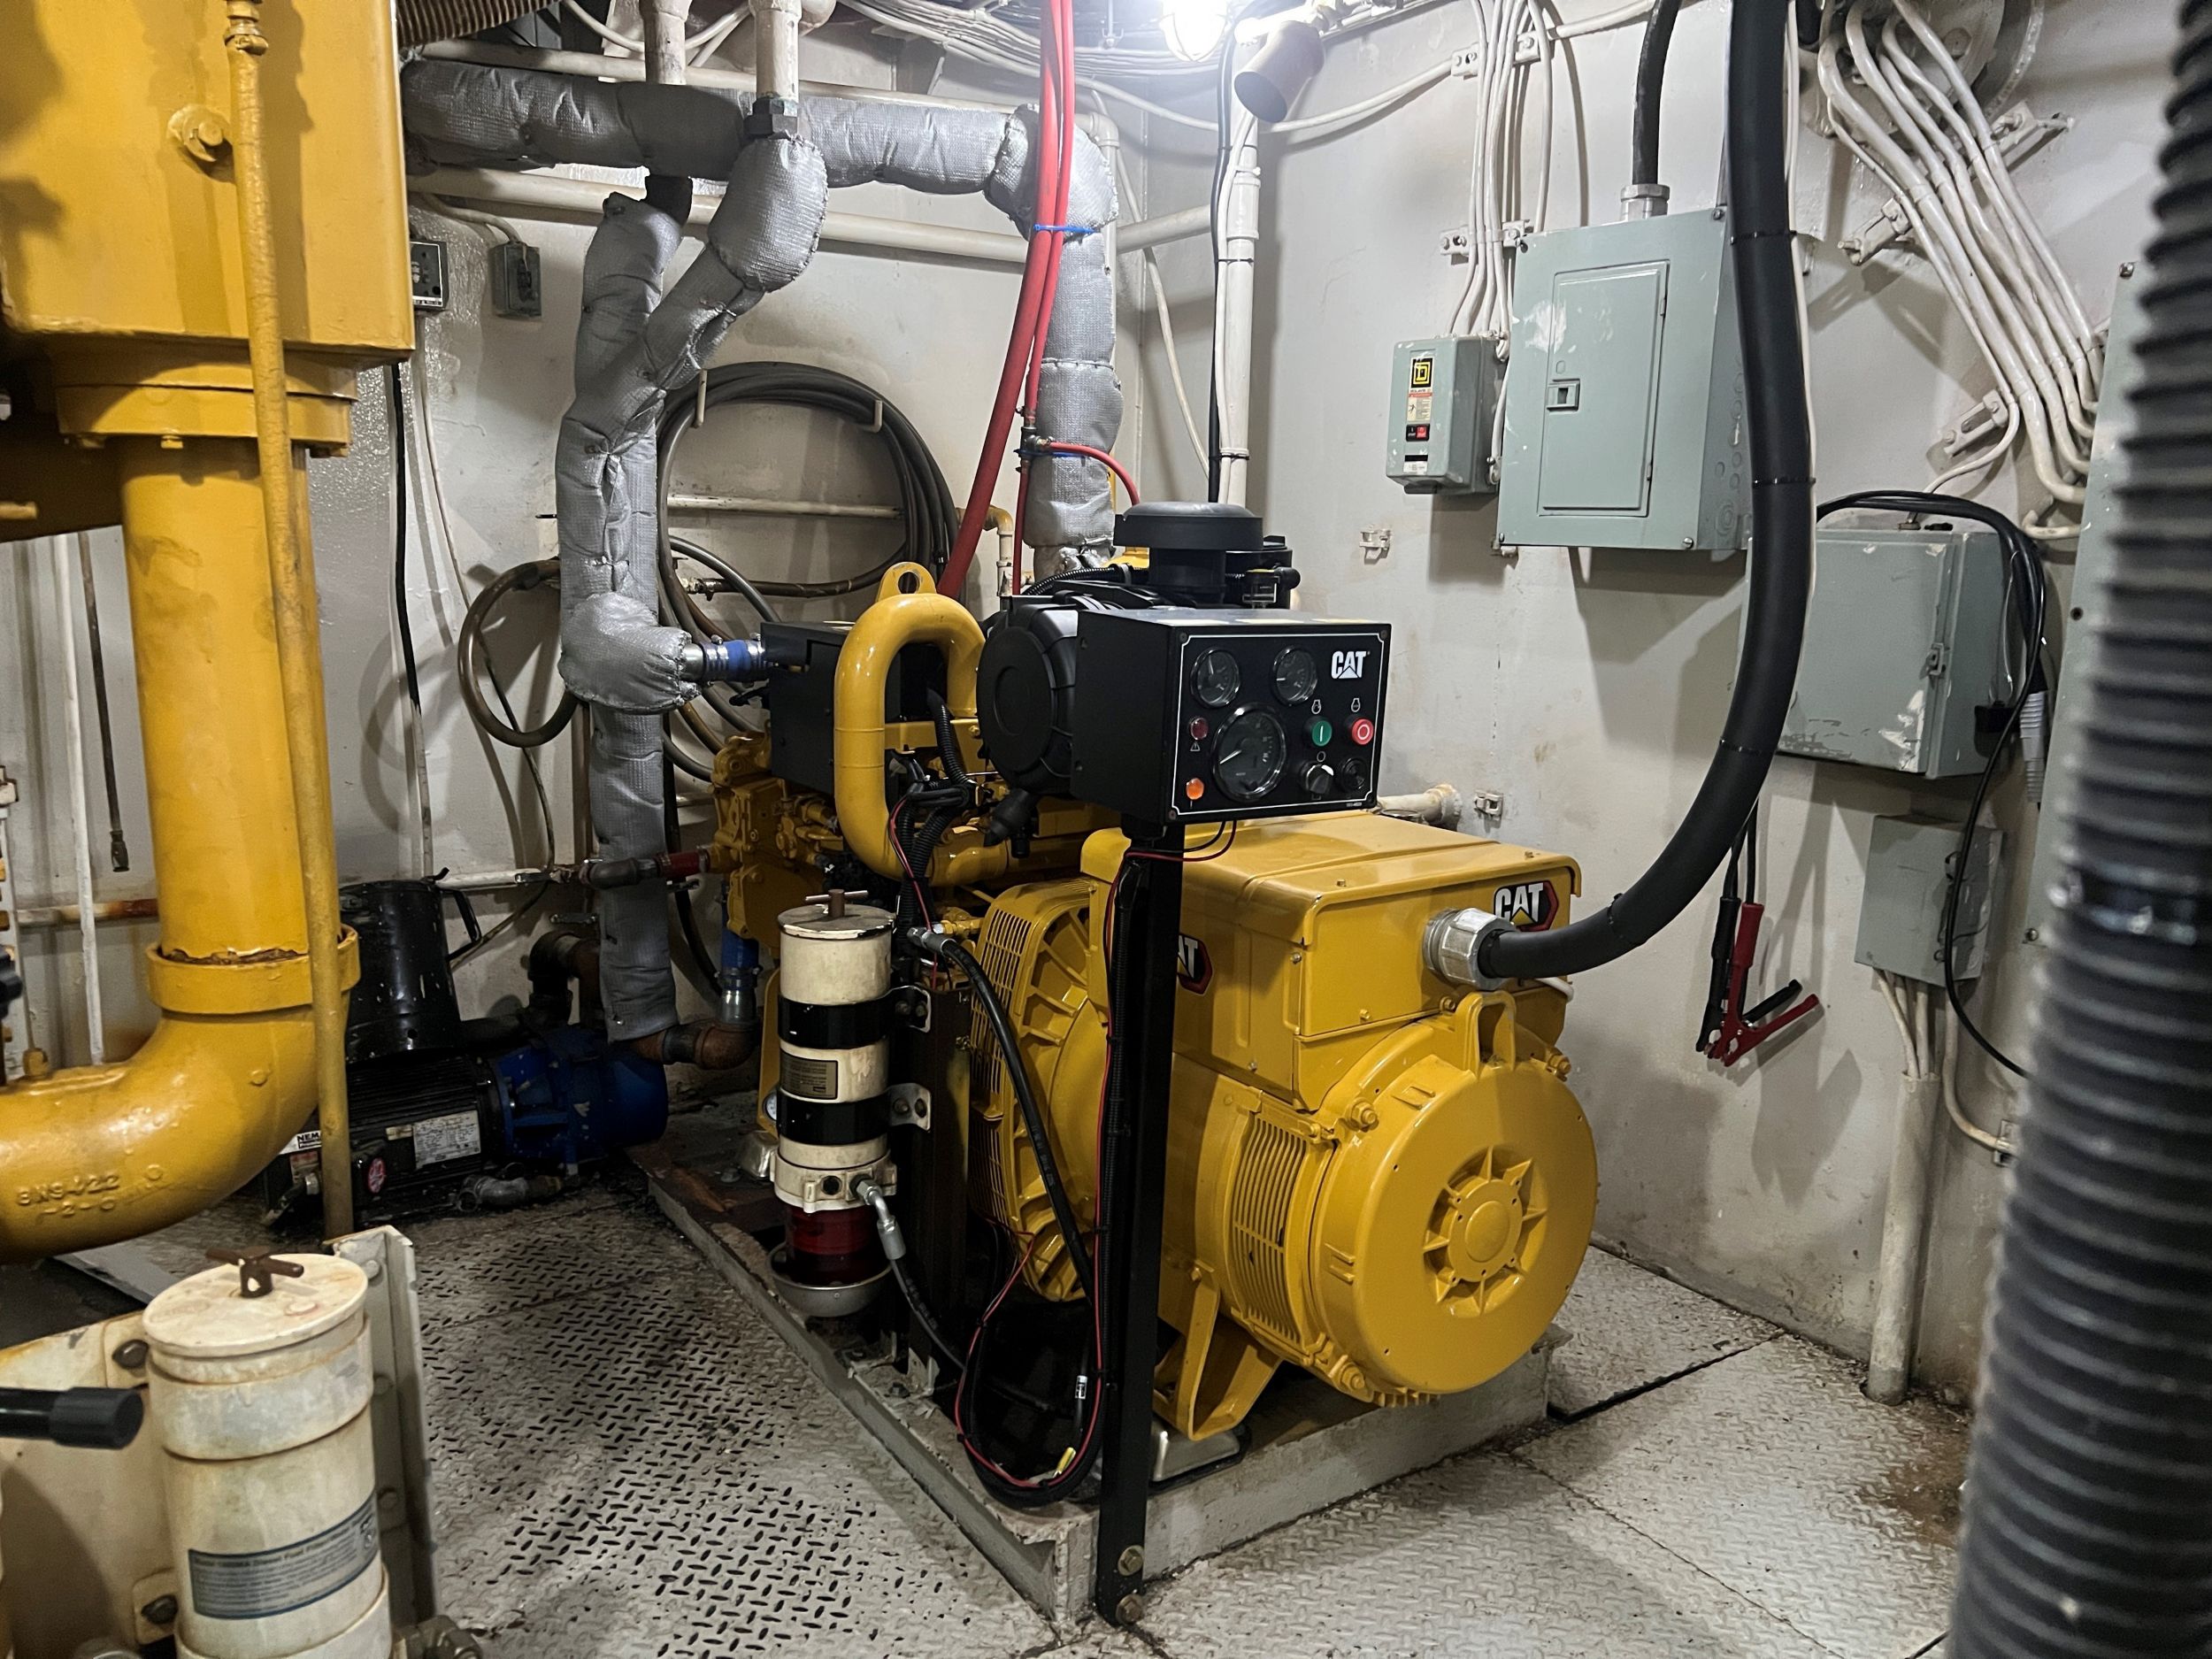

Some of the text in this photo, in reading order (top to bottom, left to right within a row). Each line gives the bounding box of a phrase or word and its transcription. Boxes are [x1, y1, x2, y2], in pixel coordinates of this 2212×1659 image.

[1331, 650, 1367, 680] CAT
[1495, 882, 1544, 923] CAT
[297, 1132, 320, 1141] NEM
